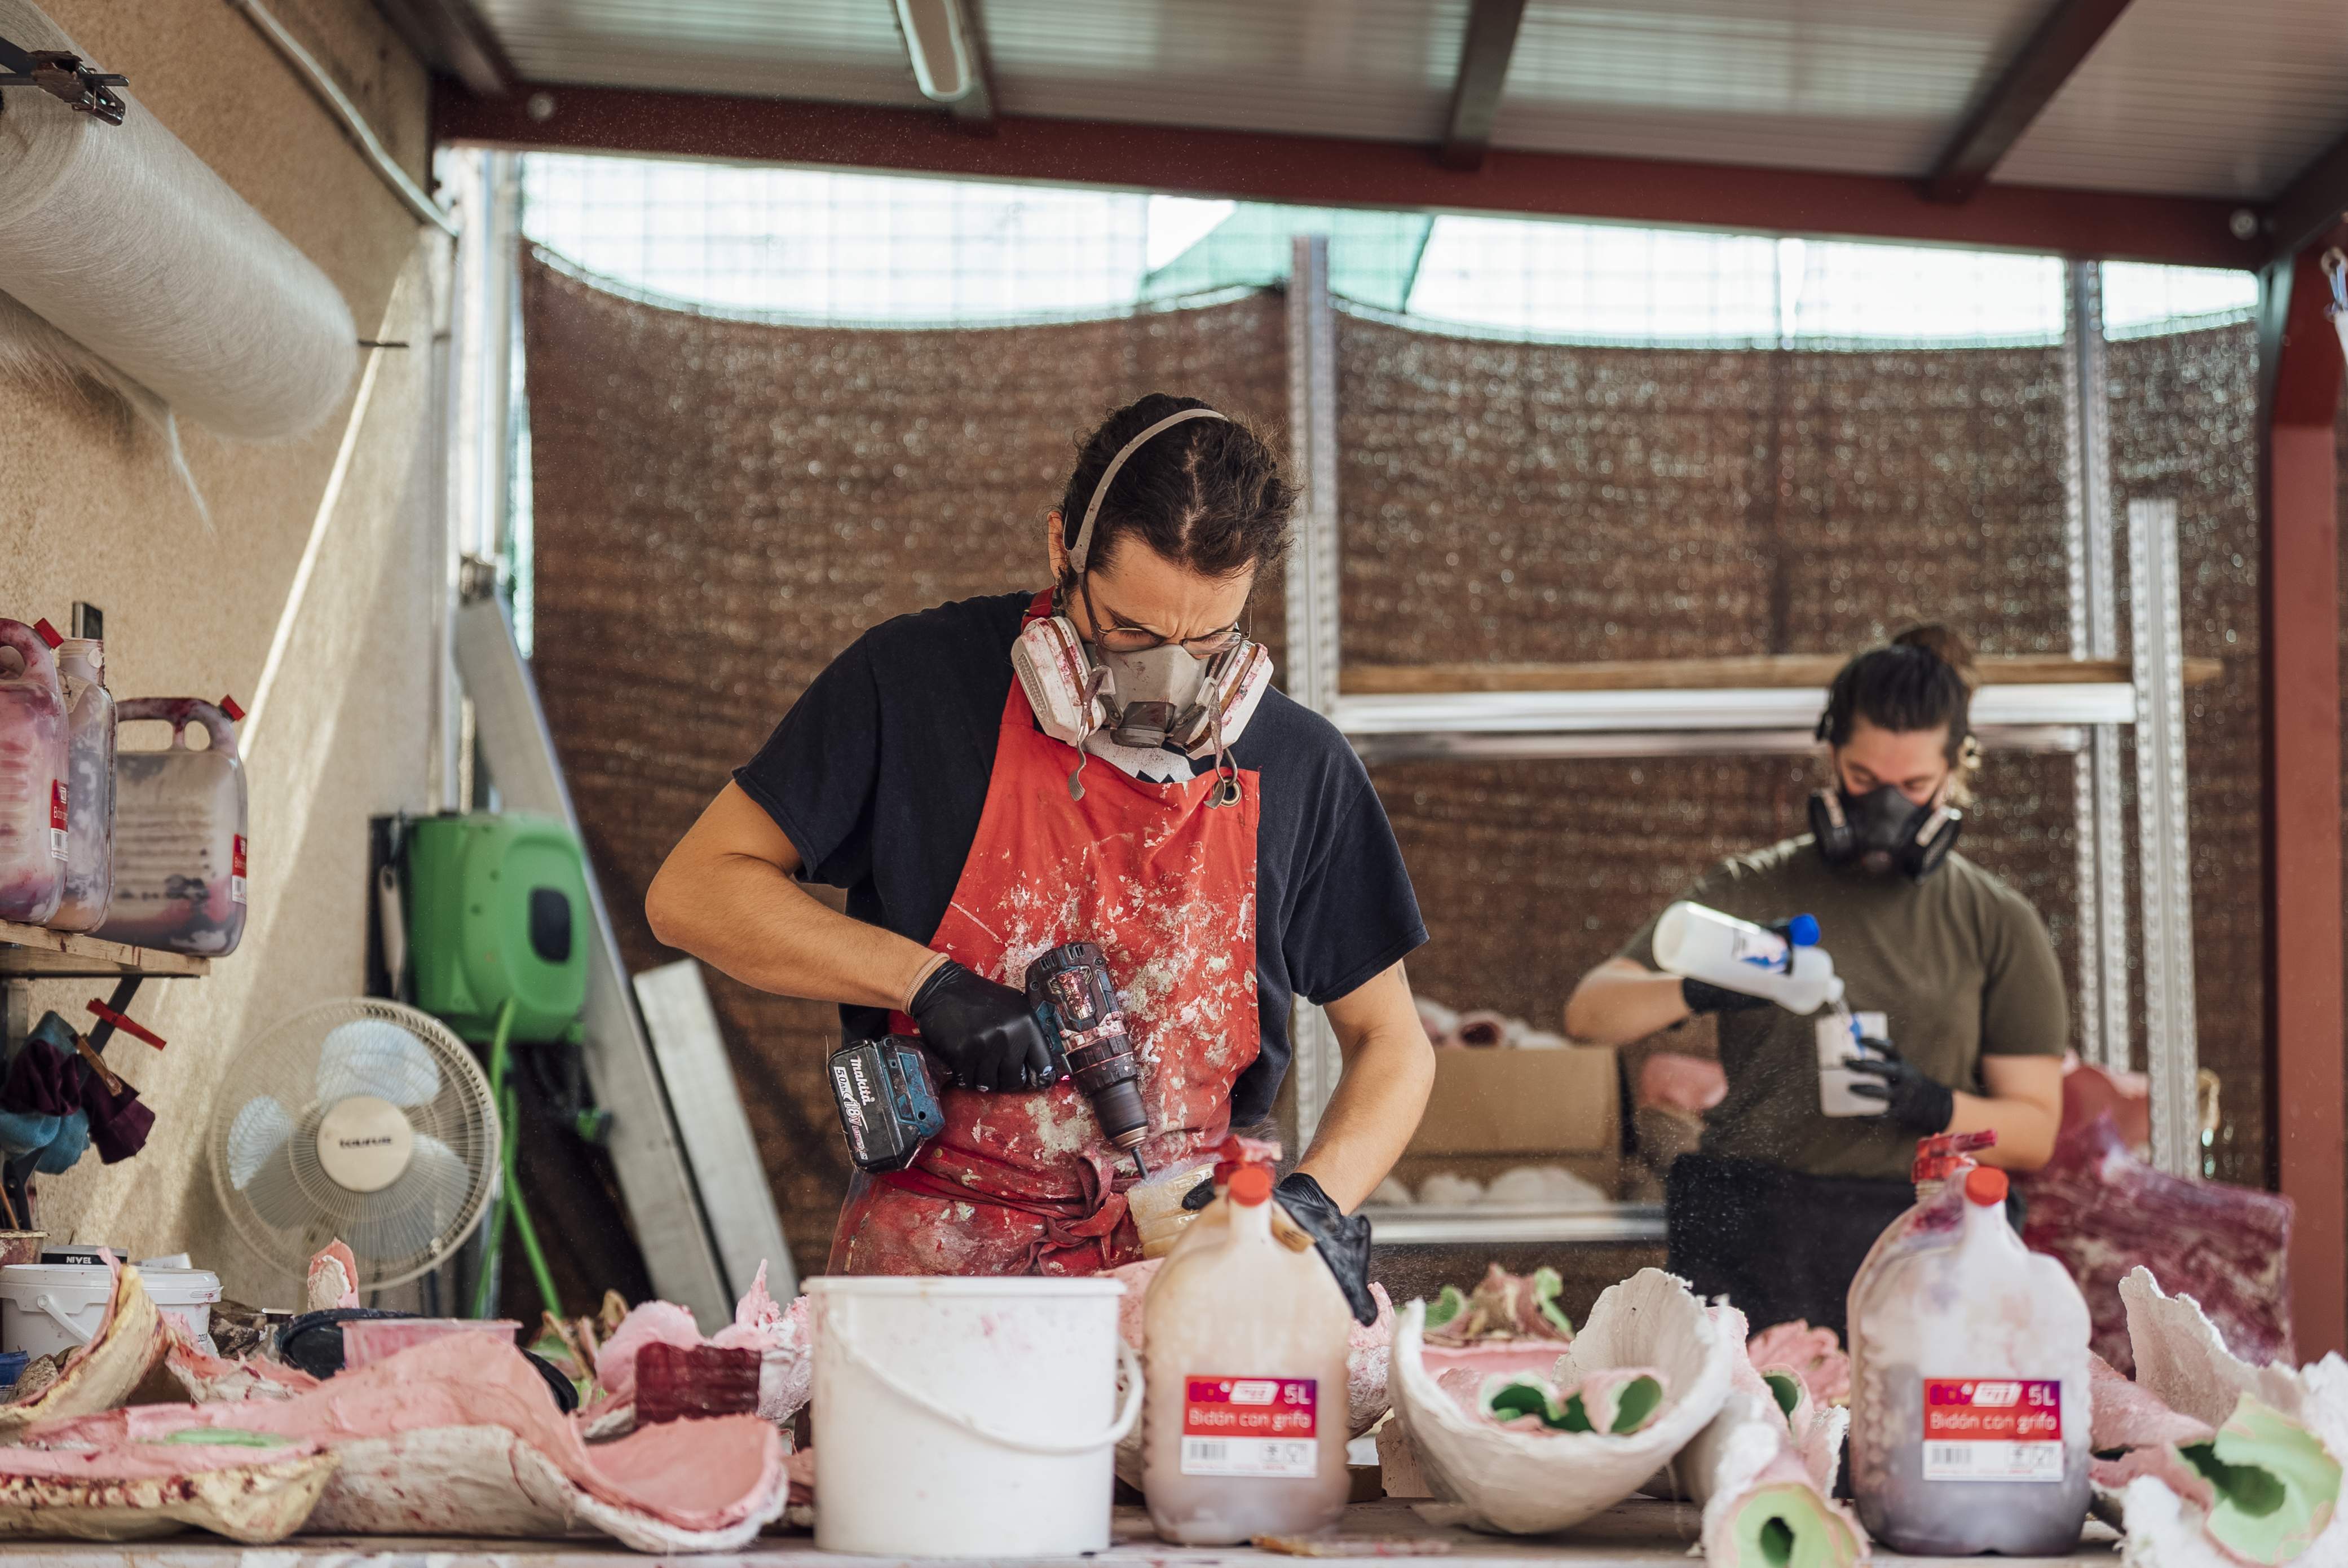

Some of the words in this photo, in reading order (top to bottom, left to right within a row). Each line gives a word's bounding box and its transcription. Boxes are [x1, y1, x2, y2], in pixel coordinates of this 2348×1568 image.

[844, 1100, 862, 1127] 18V
[67, 1256, 92, 1265] NIVEL
[1284, 1383, 1312, 1405] 5L
[2028, 1383, 2056, 1406] 5L
[1188, 1407, 1237, 1426] Bidón
[1239, 1412, 1270, 1428] con
[1272, 1410, 1313, 1432] grifo
[1930, 1410, 1980, 1430] Bidón
[1983, 1414, 2015, 1430] con
[2017, 1411, 2058, 1434] grifo
